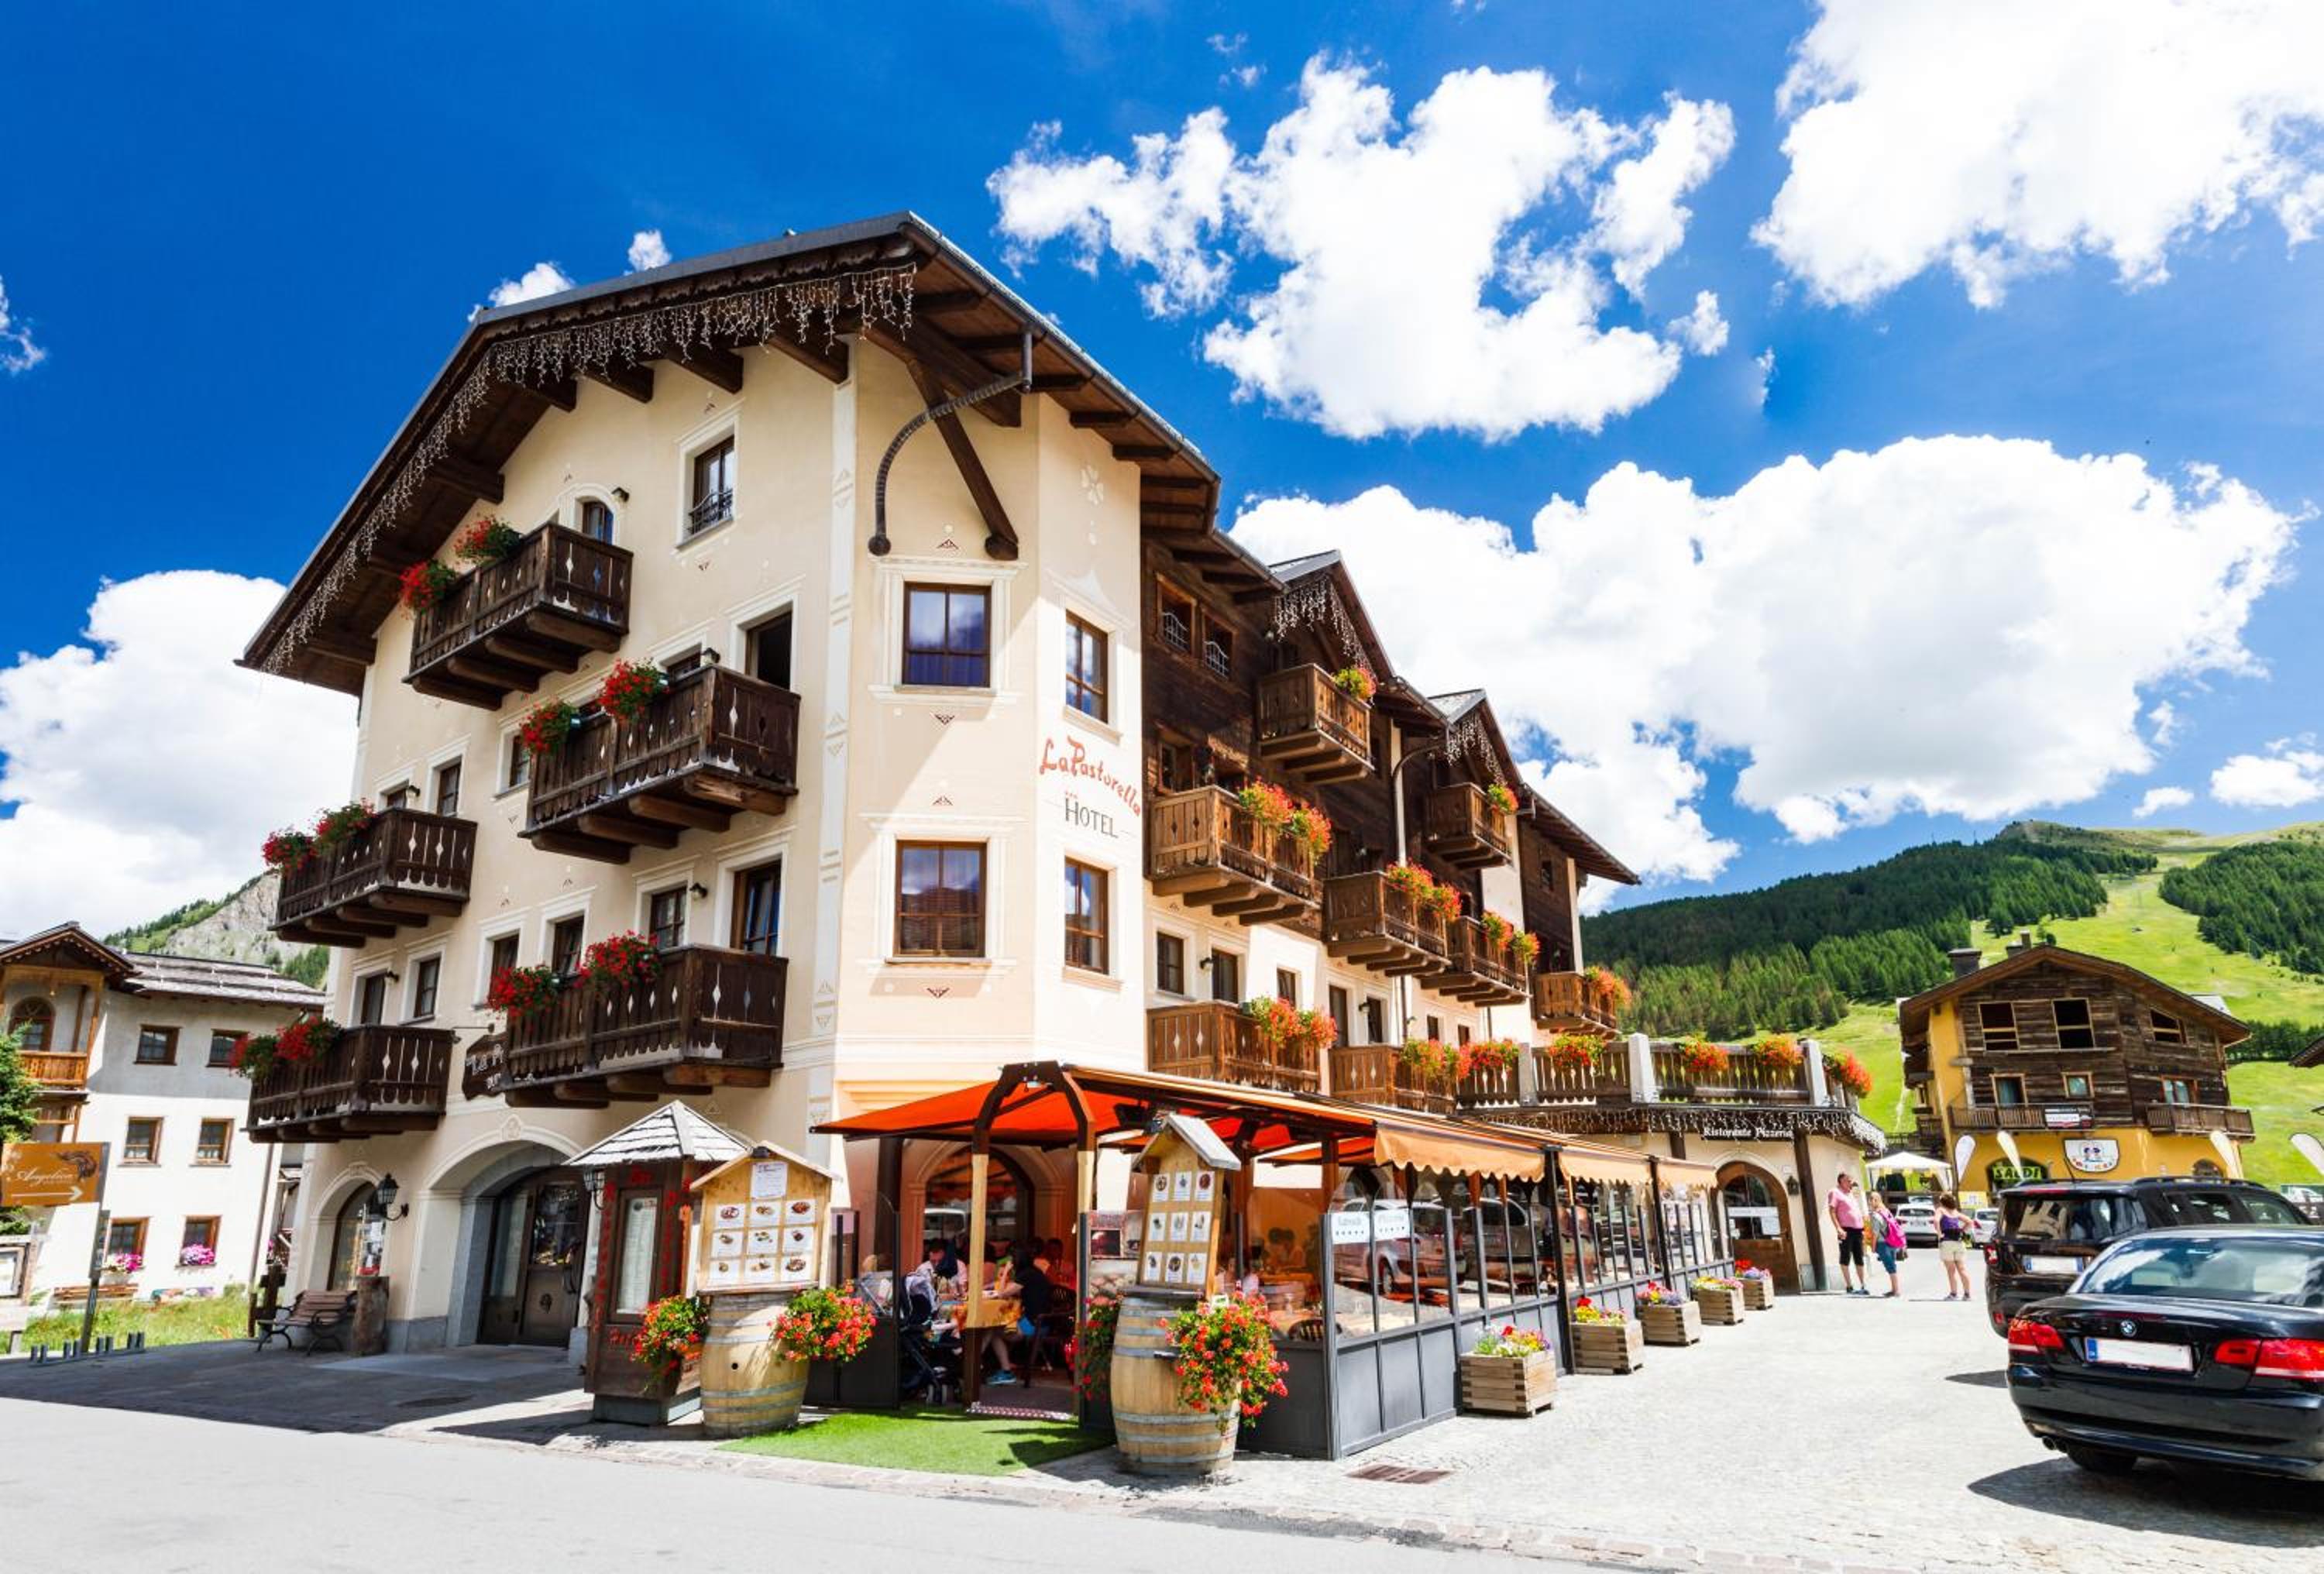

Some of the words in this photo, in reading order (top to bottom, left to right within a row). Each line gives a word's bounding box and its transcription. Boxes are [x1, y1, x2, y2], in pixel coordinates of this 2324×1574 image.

[1039, 737, 1068, 775] La
[1067, 735, 1141, 816] Pastorella
[1065, 797, 1119, 839] HOTEL
[1703, 1127, 1752, 1137] Ristorante
[1755, 1127, 1795, 1138] Pizzeria
[1995, 1167, 2040, 1178] SALDI
